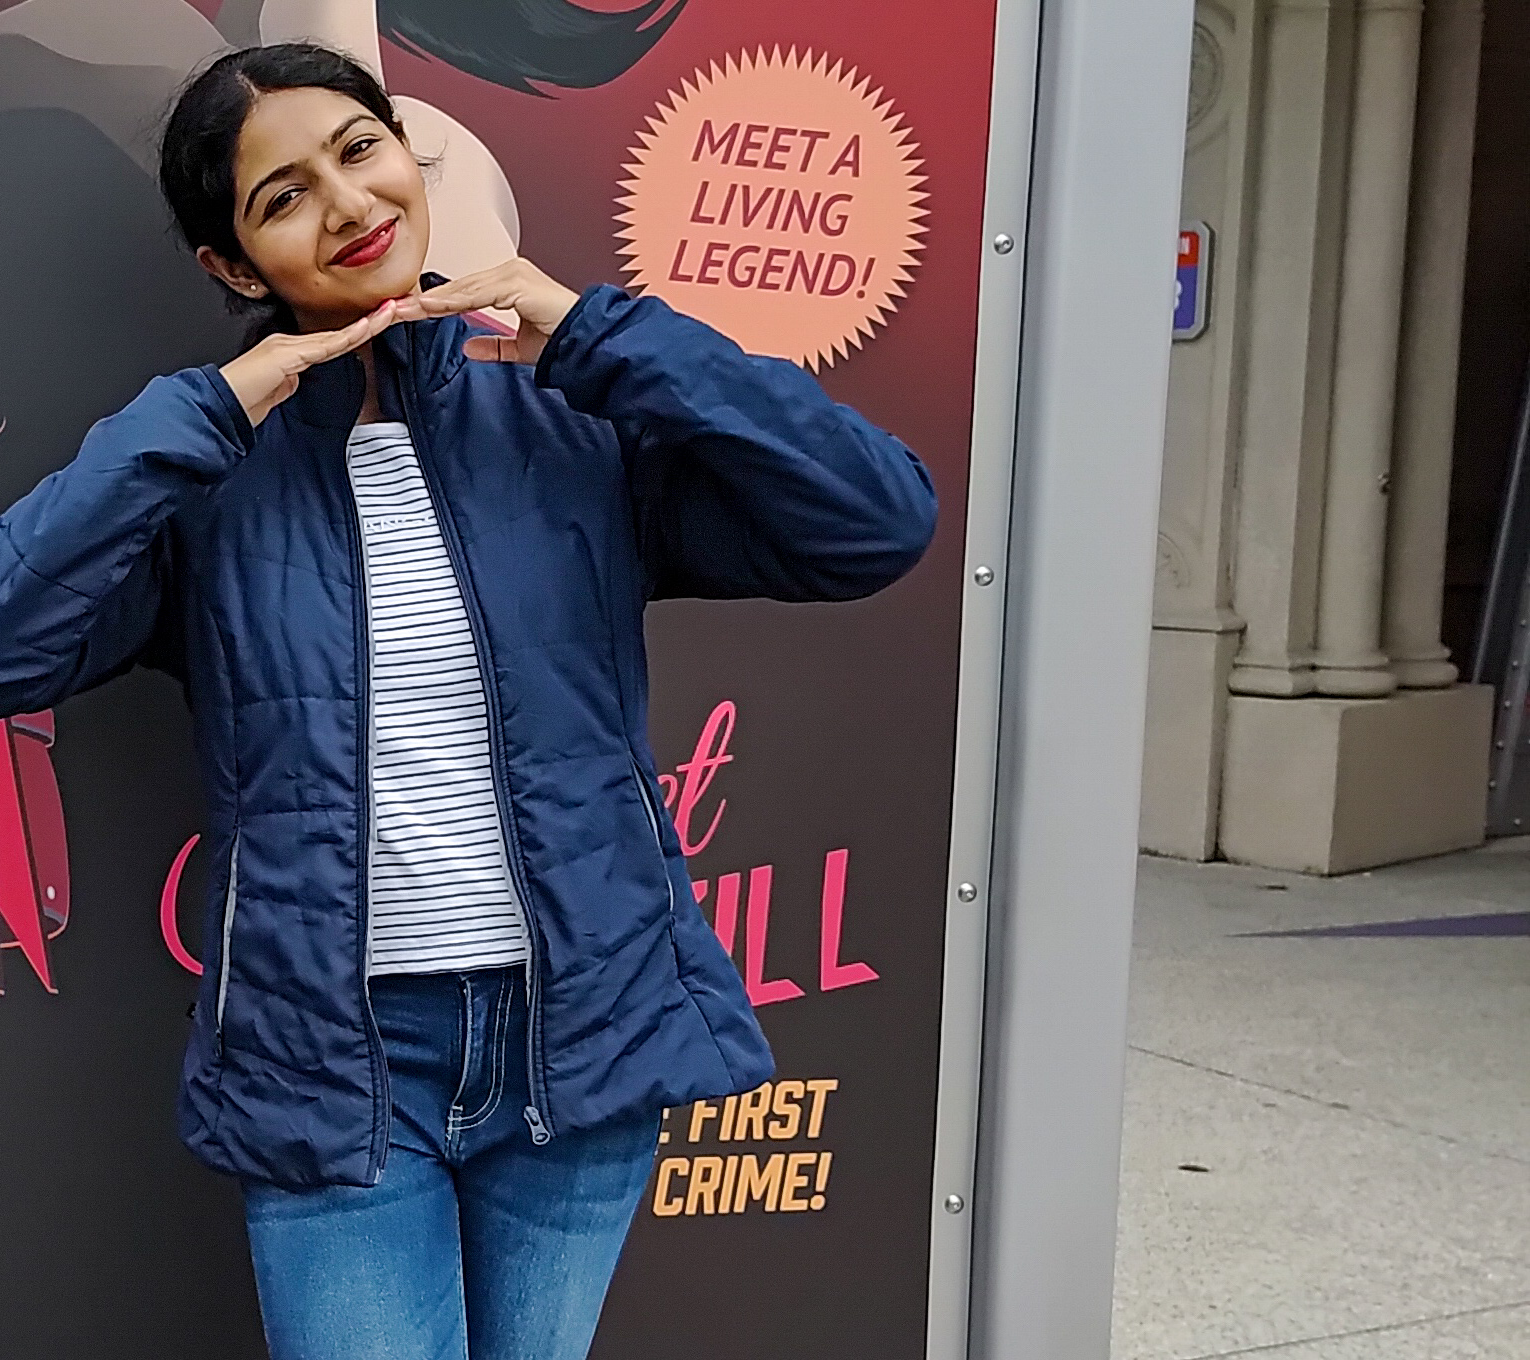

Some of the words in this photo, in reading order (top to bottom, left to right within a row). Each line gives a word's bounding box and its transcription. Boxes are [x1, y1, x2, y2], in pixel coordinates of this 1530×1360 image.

[691, 119, 830, 173] MEET
[827, 134, 861, 178] A
[690, 181, 853, 237] LIVING
[668, 239, 876, 300] LEGEND!
[688, 1079, 839, 1143] FIRST
[653, 1152, 833, 1217] CRIME!
